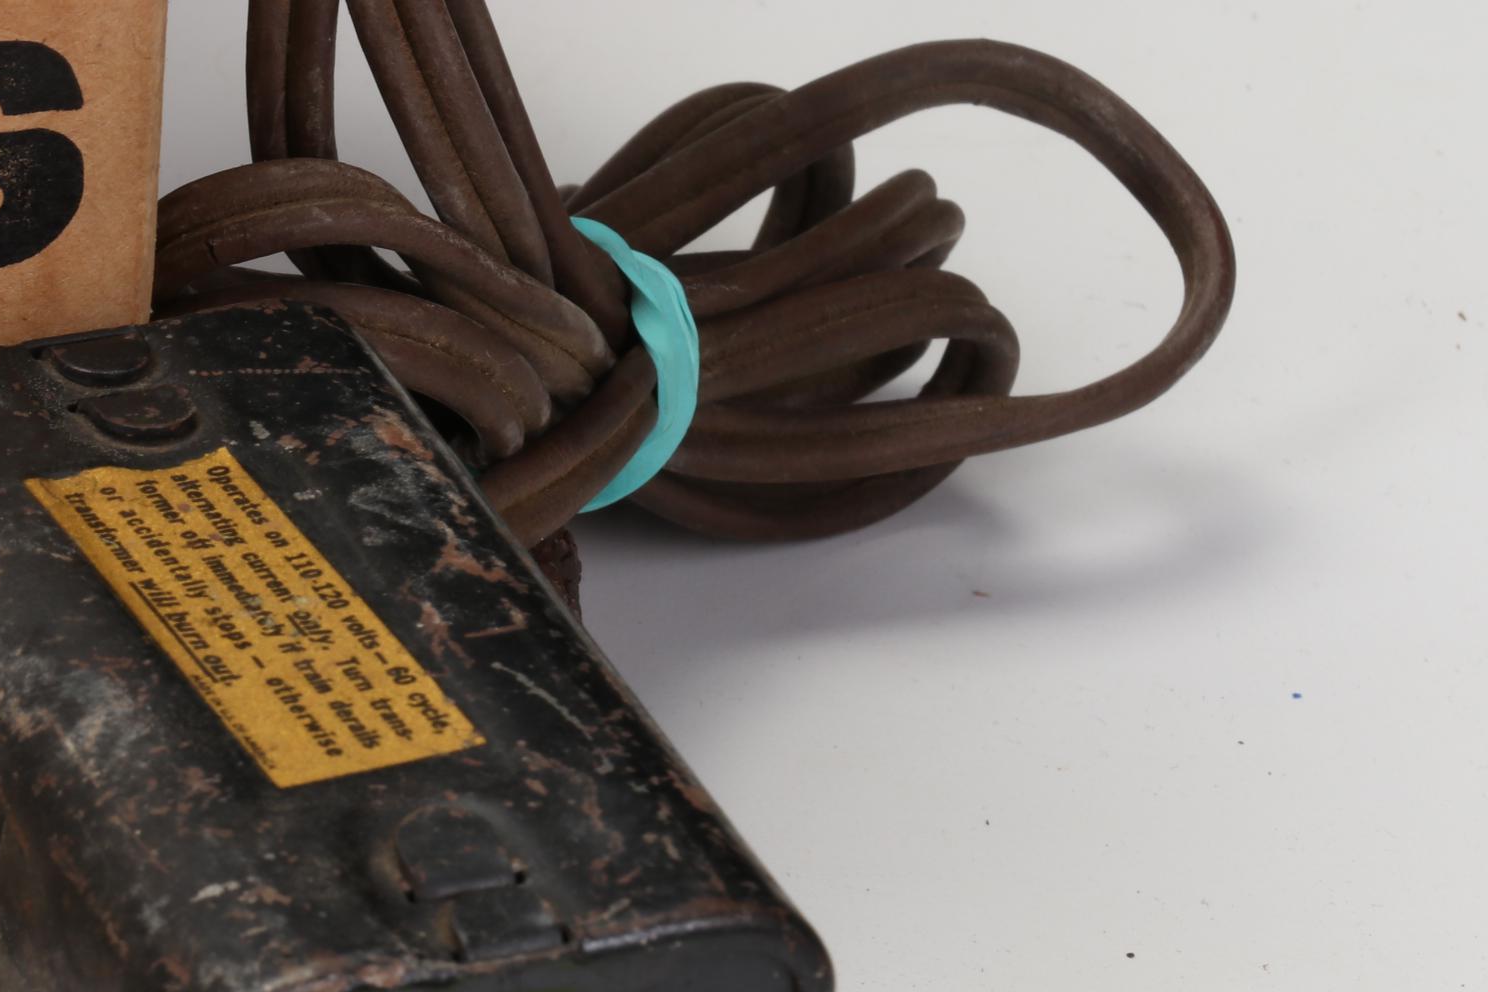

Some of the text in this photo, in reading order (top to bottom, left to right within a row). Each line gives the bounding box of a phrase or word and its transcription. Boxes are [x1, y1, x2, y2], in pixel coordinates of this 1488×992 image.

[63, 492, 242, 687] transformer will burn out.
[100, 487, 124, 501] or
[118, 510, 214, 600] accidentally
[204, 607, 252, 650] stops
[266, 677, 343, 757] otherwise
[135, 480, 185, 524] former
[180, 530, 210, 549] off
[278, 641, 305, 653] if
[293, 659, 332, 694] train
[328, 701, 380, 749] derails
[170, 474, 246, 547] alternating
[242, 552, 294, 603] current
[336, 656, 374, 692] Turn
[370, 698, 413, 741] trans-
[206, 466, 269, 525] Operates
[264, 529, 291, 549] on
